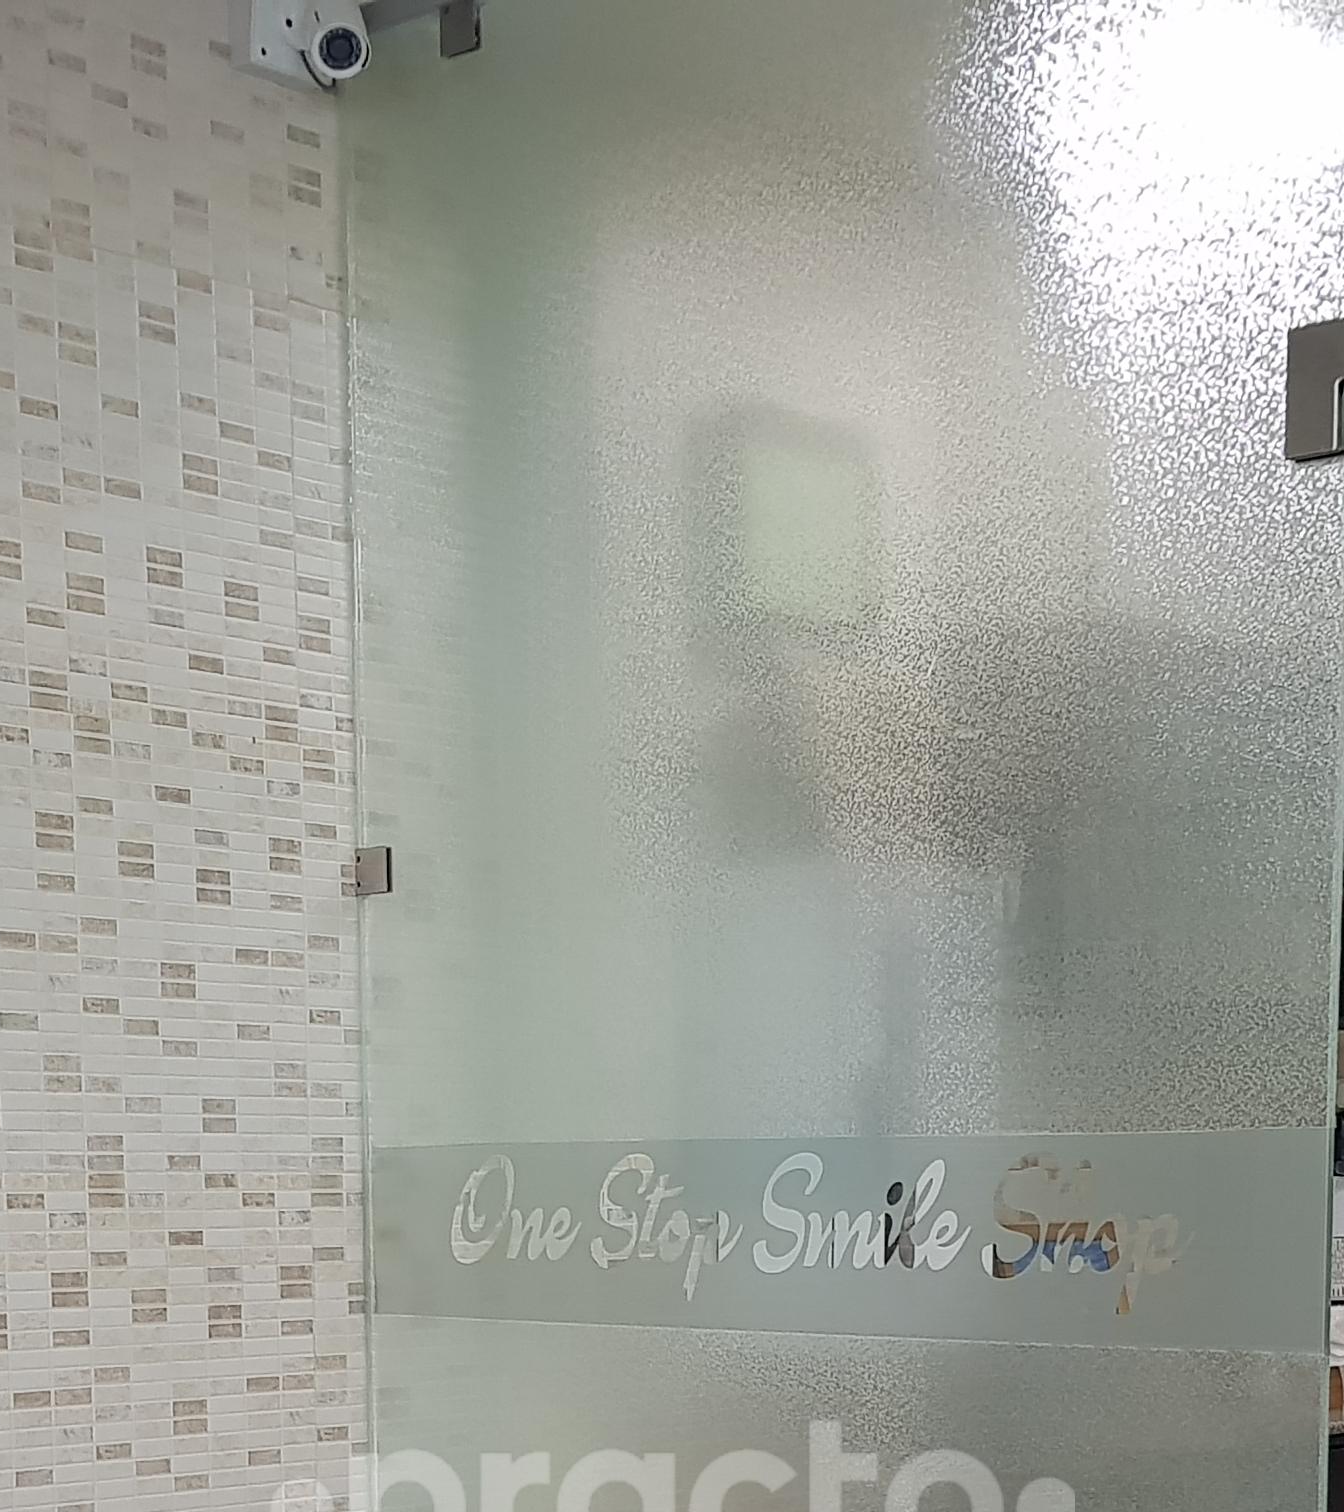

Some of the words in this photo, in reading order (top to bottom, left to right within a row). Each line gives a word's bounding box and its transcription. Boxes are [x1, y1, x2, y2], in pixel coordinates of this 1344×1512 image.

[450, 1152, 582, 1266] One
[590, 1152, 743, 1302] Stop
[752, 1150, 970, 1274] Smile
